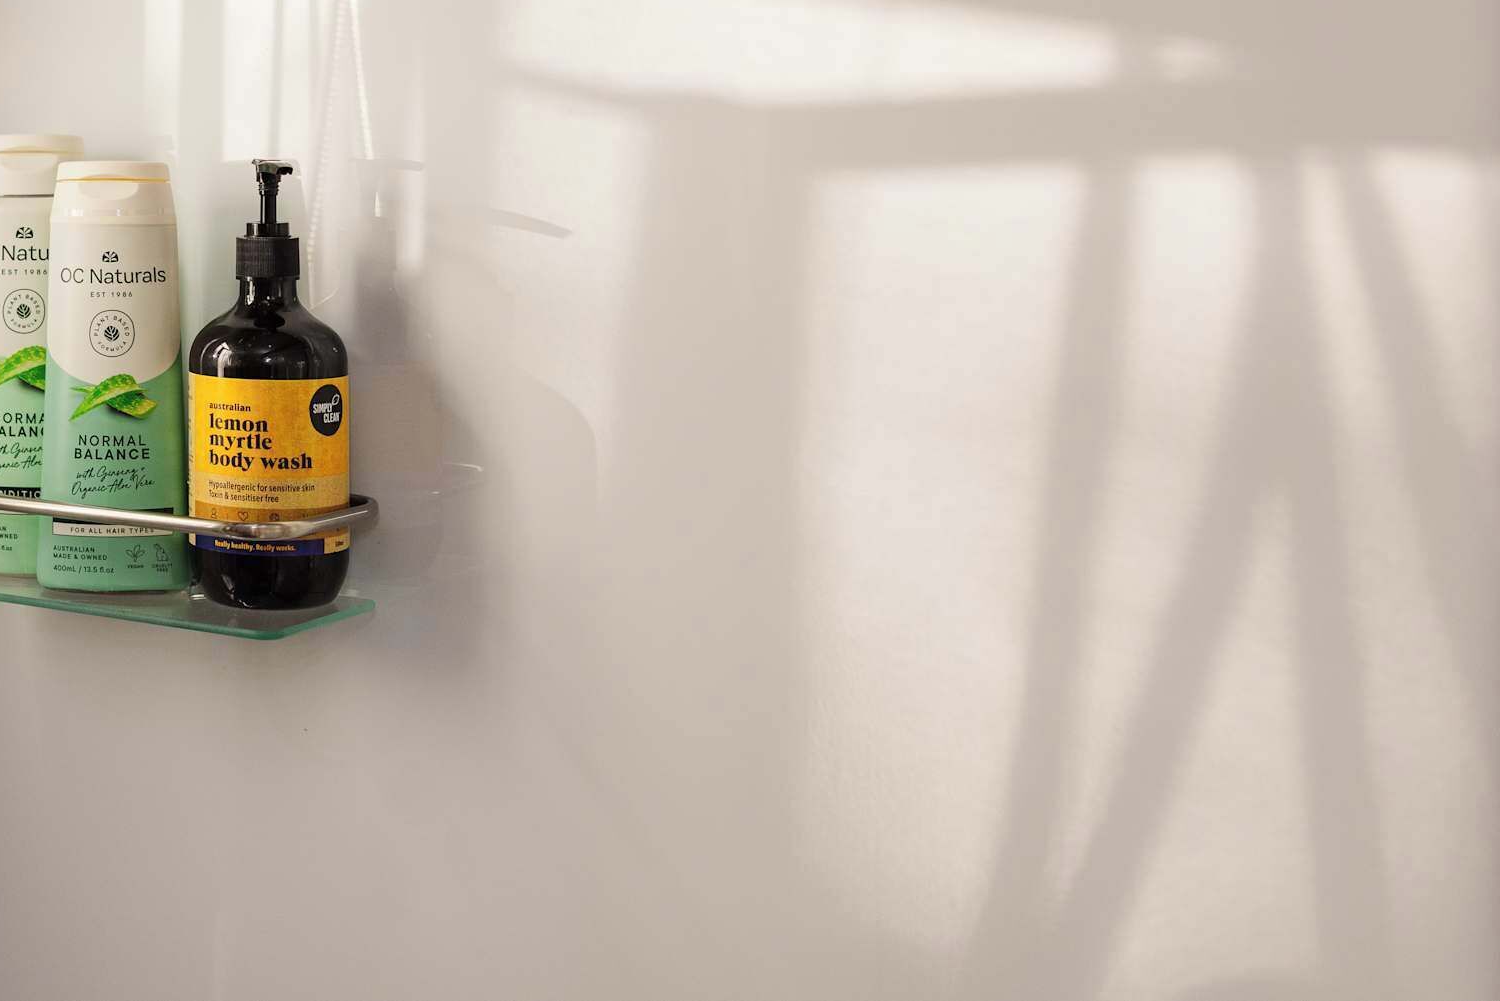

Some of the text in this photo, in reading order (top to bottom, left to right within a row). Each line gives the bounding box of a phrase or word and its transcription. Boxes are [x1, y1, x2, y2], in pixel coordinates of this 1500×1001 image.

[60, 266, 166, 284] OC Naturals
[94, 315, 130, 336] PLANT BASED
[209, 402, 251, 412] australian
[312, 402, 333, 415] SIMPLY
[210, 413, 268, 432] lemon
[323, 412, 341, 424] CLEAN
[78, 434, 147, 446] NORMAL
[210, 433, 272, 450] myrtle
[74, 448, 150, 460] BALANCE
[210, 449, 313, 471] body wash
[76, 467, 95, 480] with
[71, 481, 108, 499] Organic
[107, 478, 132, 493] Aloe
[208, 479, 315, 493] Hypoallergenic for sensitive skin
[209, 489, 279, 503] Toxin & sensitiser free
[53, 545, 95, 553] AUSTRALIAN
